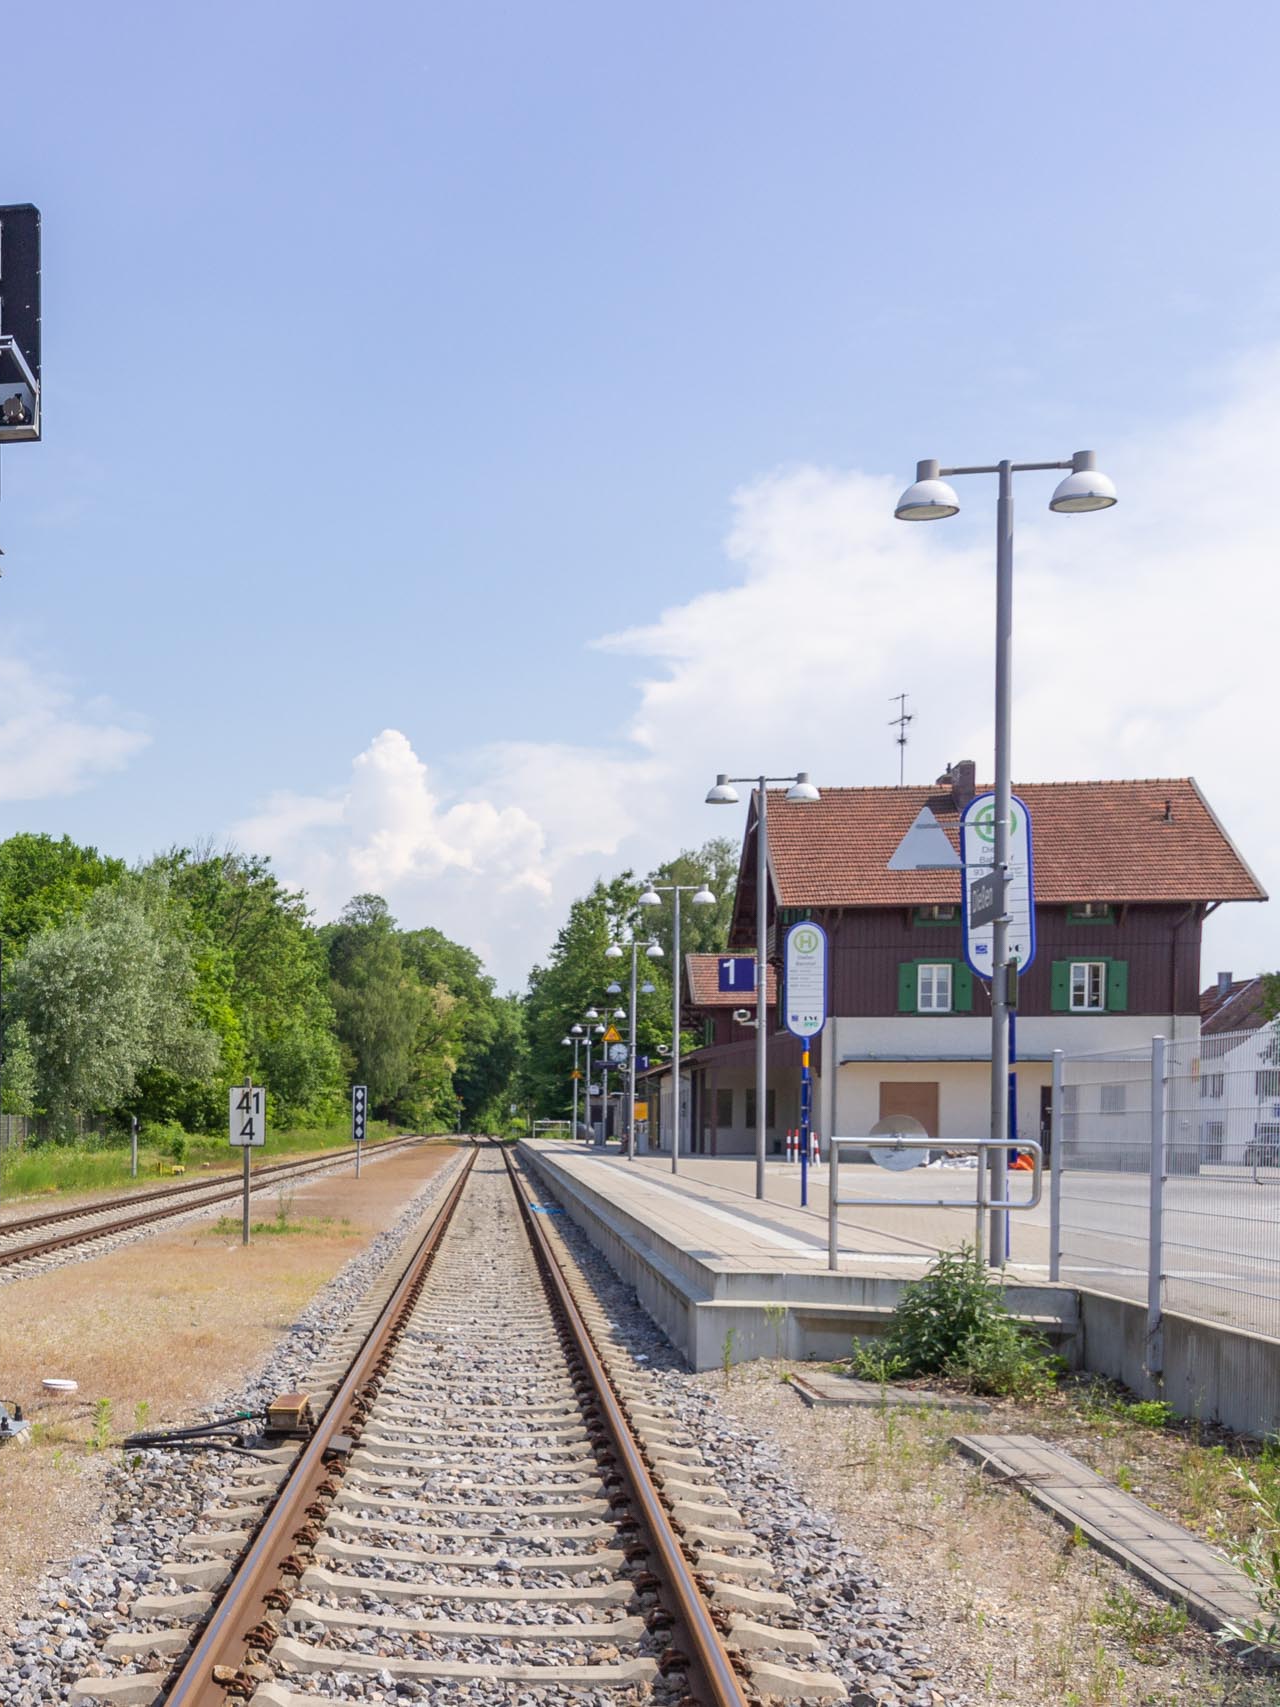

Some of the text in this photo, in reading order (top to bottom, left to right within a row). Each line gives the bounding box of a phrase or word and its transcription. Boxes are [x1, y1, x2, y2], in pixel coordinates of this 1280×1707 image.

[800, 935, 812, 949] H
[723, 958, 735, 985] 1
[642, 1056, 649, 1068] 1
[236, 1091, 260, 1114] 41
[239, 1117, 255, 1141] 4
